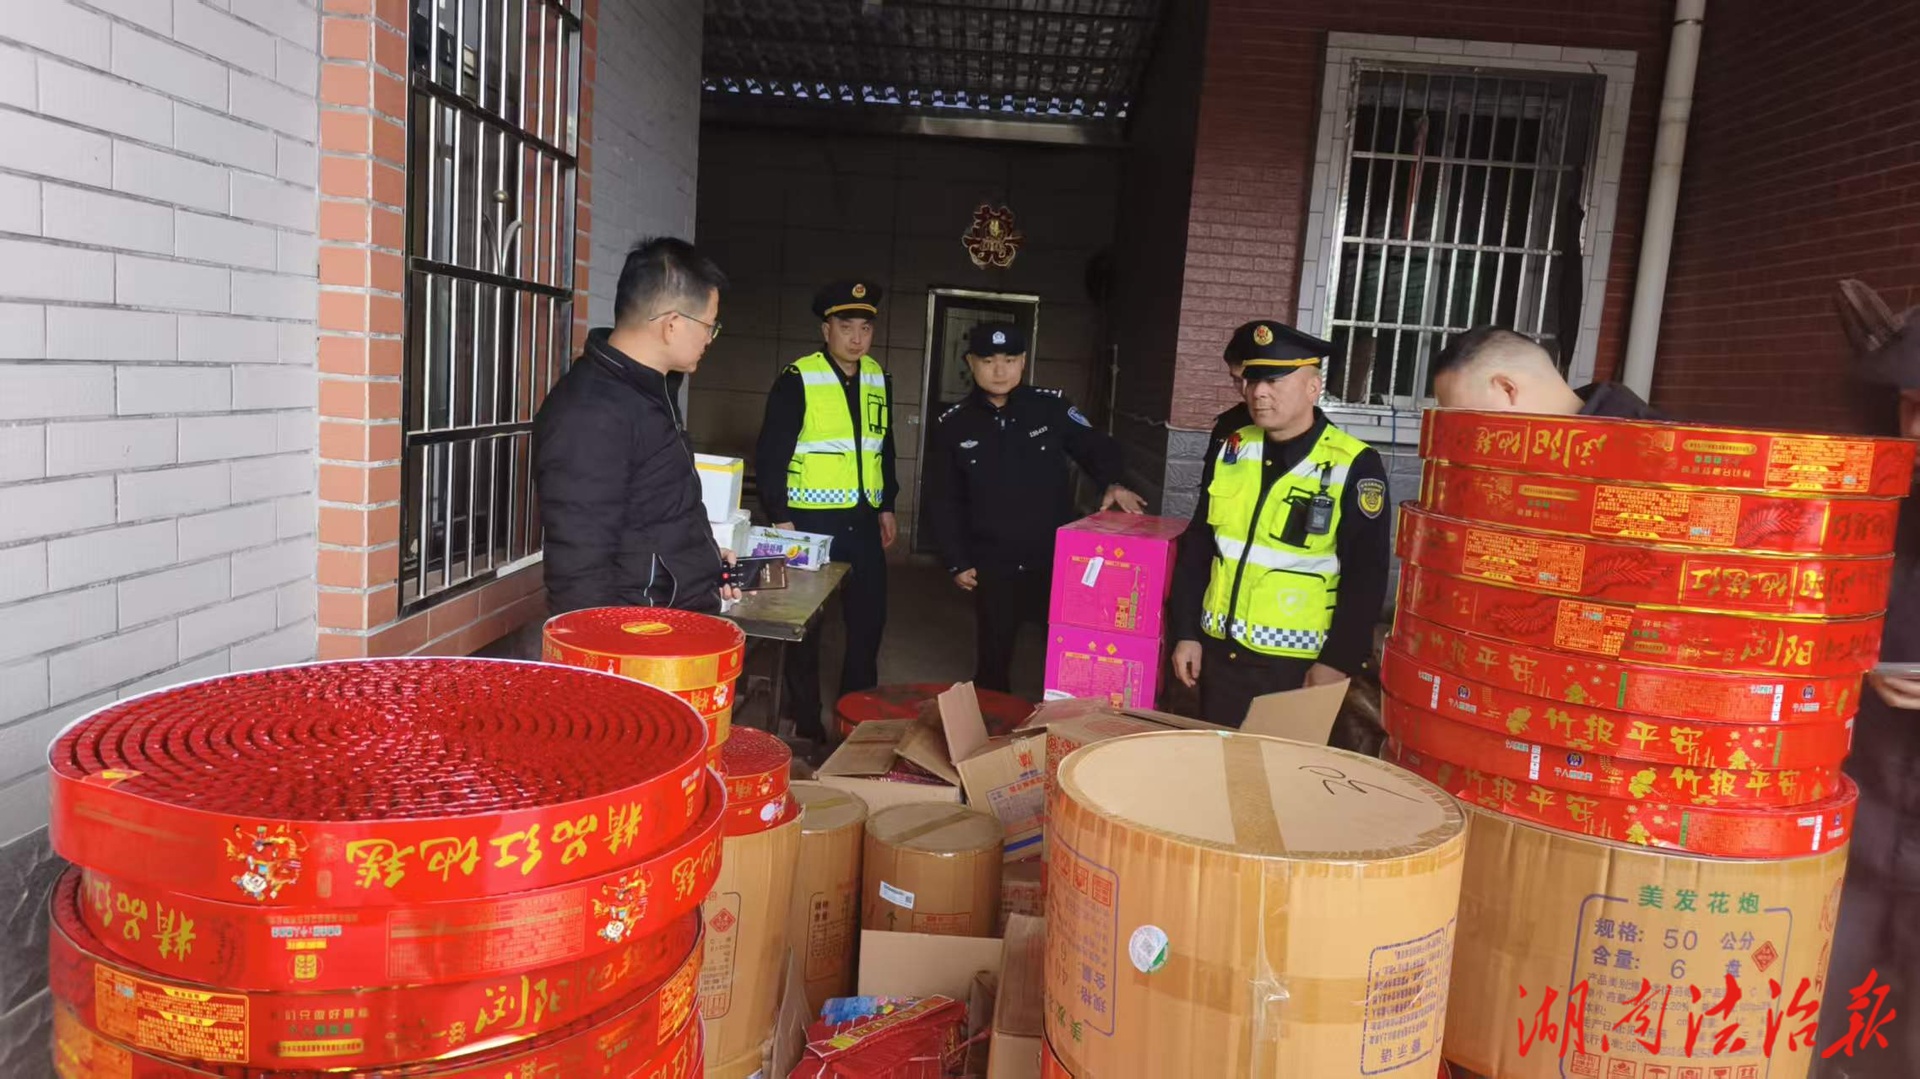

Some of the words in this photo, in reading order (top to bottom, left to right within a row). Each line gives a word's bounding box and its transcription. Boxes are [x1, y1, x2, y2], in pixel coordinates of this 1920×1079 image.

[1430, 631, 1539, 683] 竹报平安
[1542, 706, 1702, 756] 竹报平安
[1463, 767, 1600, 823] 竹报平安
[1669, 766, 1801, 798] 竹报平安
[345, 801, 643, 889] 精品红地毯
[84, 868, 197, 963] 精品红
[1636, 885, 1760, 915] 美发花炮
[1663, 929, 1698, 951] 50
[1720, 931, 1756, 951] 公分
[1670, 959, 1687, 980] 6
[1724, 959, 1743, 979] 盘
